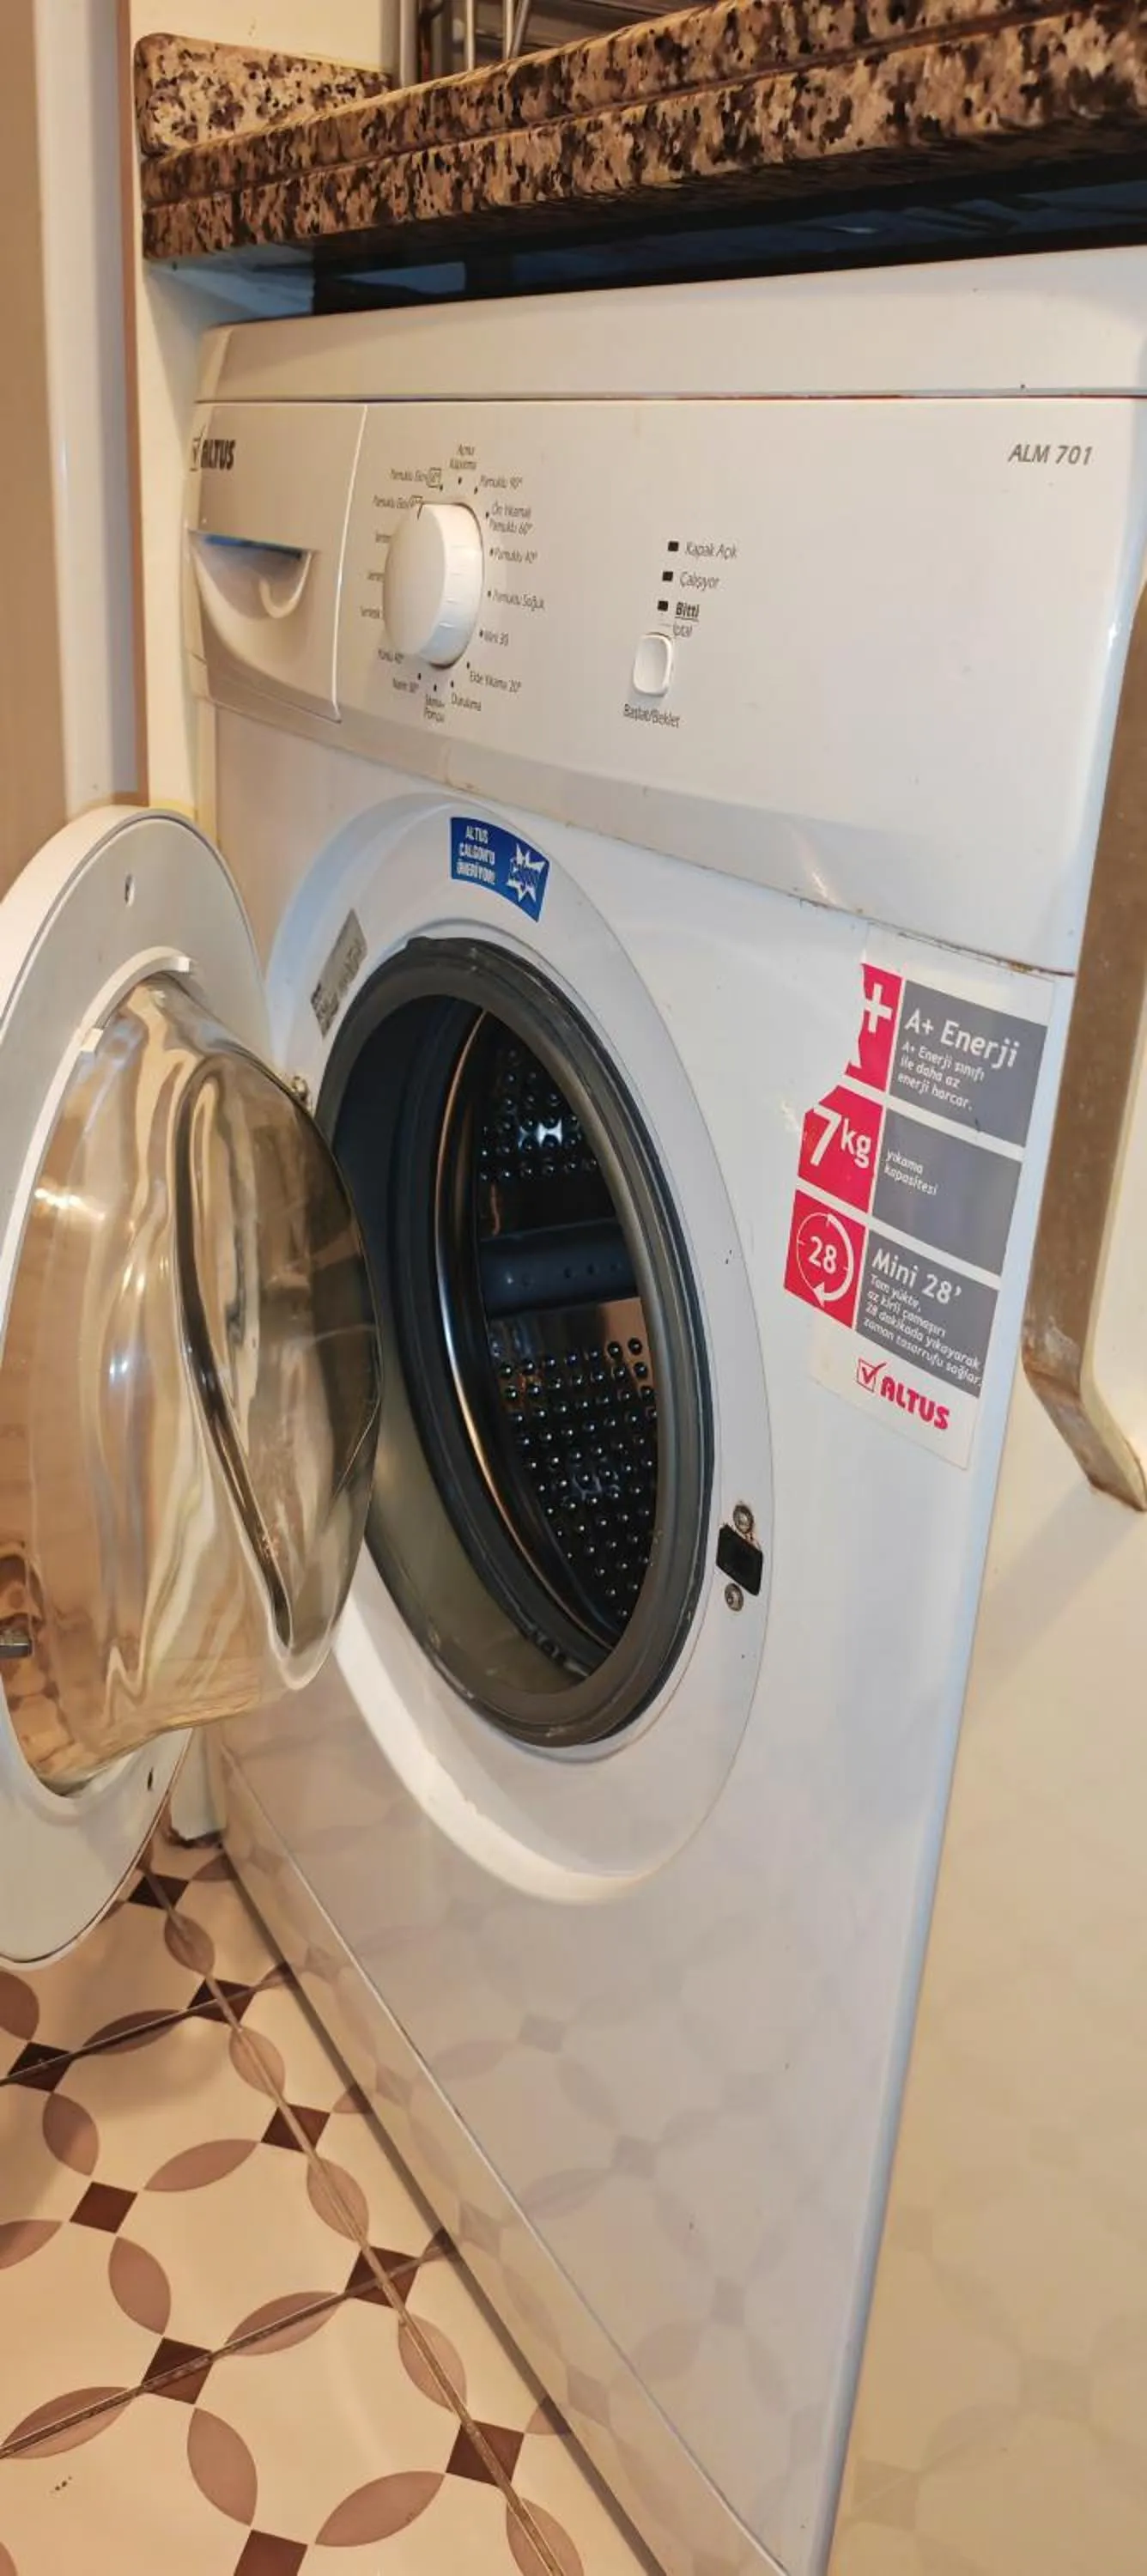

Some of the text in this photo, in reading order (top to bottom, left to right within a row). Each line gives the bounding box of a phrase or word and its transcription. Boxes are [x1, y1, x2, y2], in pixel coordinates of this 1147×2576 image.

[201, 439, 236, 471] ALTUS
[1007, 443, 1093, 465] ALM 701
[686, 541, 714, 558] Kapak
[675, 602, 700, 618] Bitti
[465, 825, 489, 844] ALTUS
[904, 1007, 1020, 1069] A+ Enerji
[901, 1041, 986, 1082] A+ Enerji sınıfı
[916, 1062, 944, 1082] daha
[945, 1075, 962, 1090] az
[897, 1072, 974, 1112] enerji harcar.
[883, 1163, 938, 1196] kapasitesi
[886, 1148, 924, 1176] yıkama
[808, 1236, 837, 1274] 28
[871, 1248, 919, 1288] Mini
[870, 1273, 921, 1313] Tam yükte,
[867, 1291, 947, 1338] az kirli çamaşırı
[863, 1317, 984, 1387] zaman tasarrufu sağlar.
[865, 1301, 981, 1370] 28 dakikada yıkayarak
[880, 1376, 950, 1430] ALTUS
